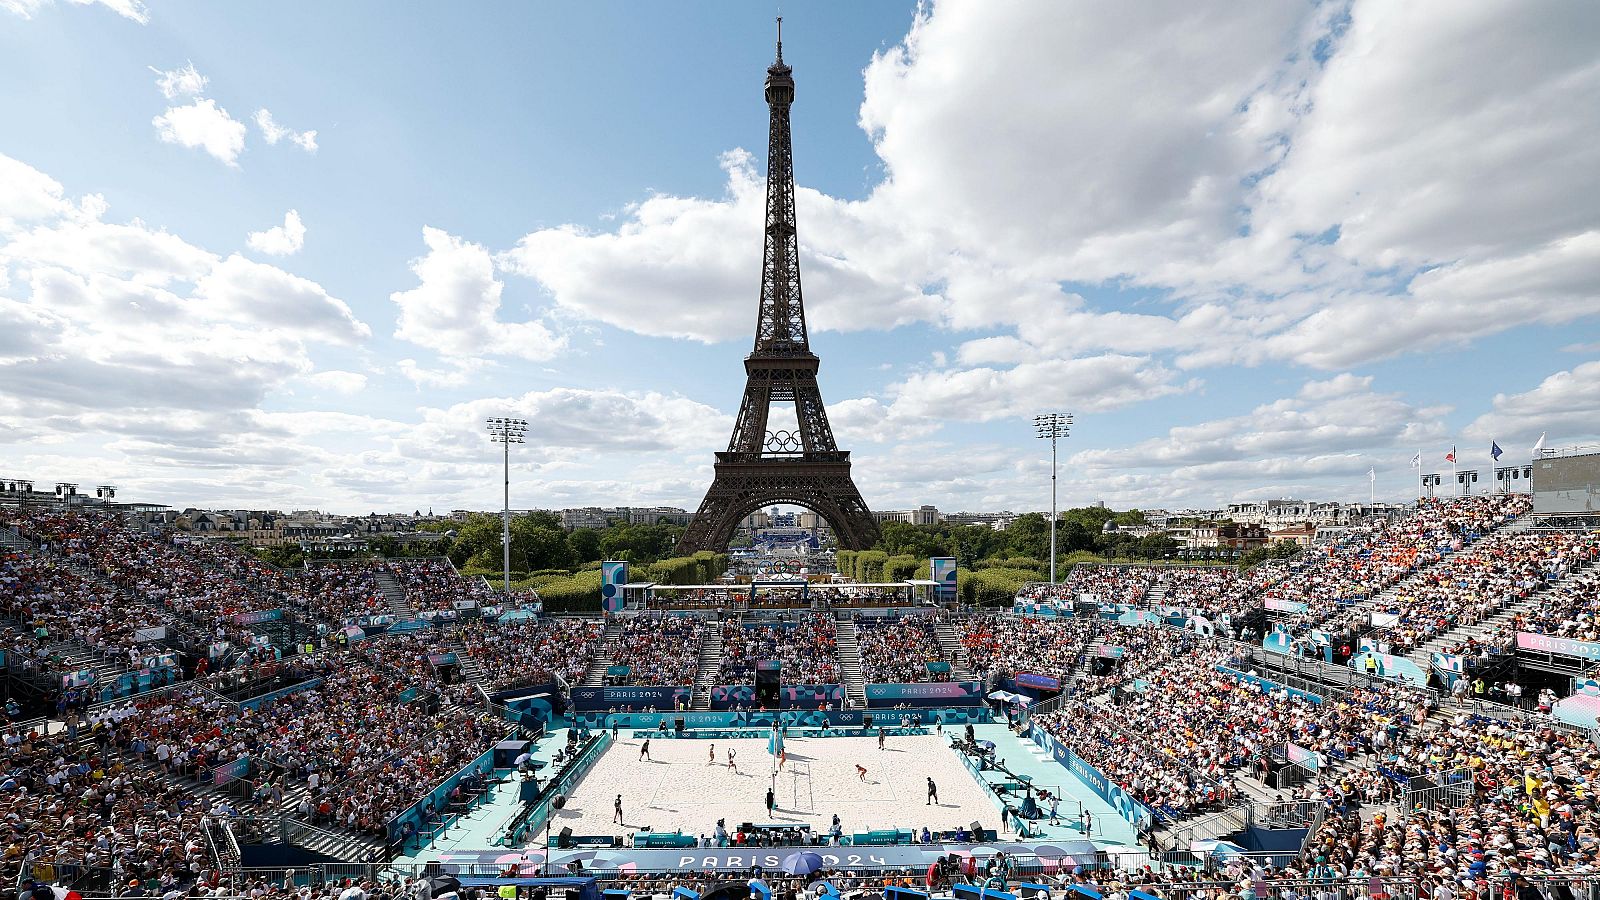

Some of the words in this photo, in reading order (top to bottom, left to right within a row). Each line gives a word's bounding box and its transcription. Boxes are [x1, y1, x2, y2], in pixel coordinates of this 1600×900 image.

[1530, 638, 1567, 651] PARIS
[1571, 644, 1600, 655] 202
[670, 715, 696, 723] PIS
[1089, 774, 1105, 792] 2024
[679, 855, 779, 868] PARIS
[822, 855, 886, 866] 024
